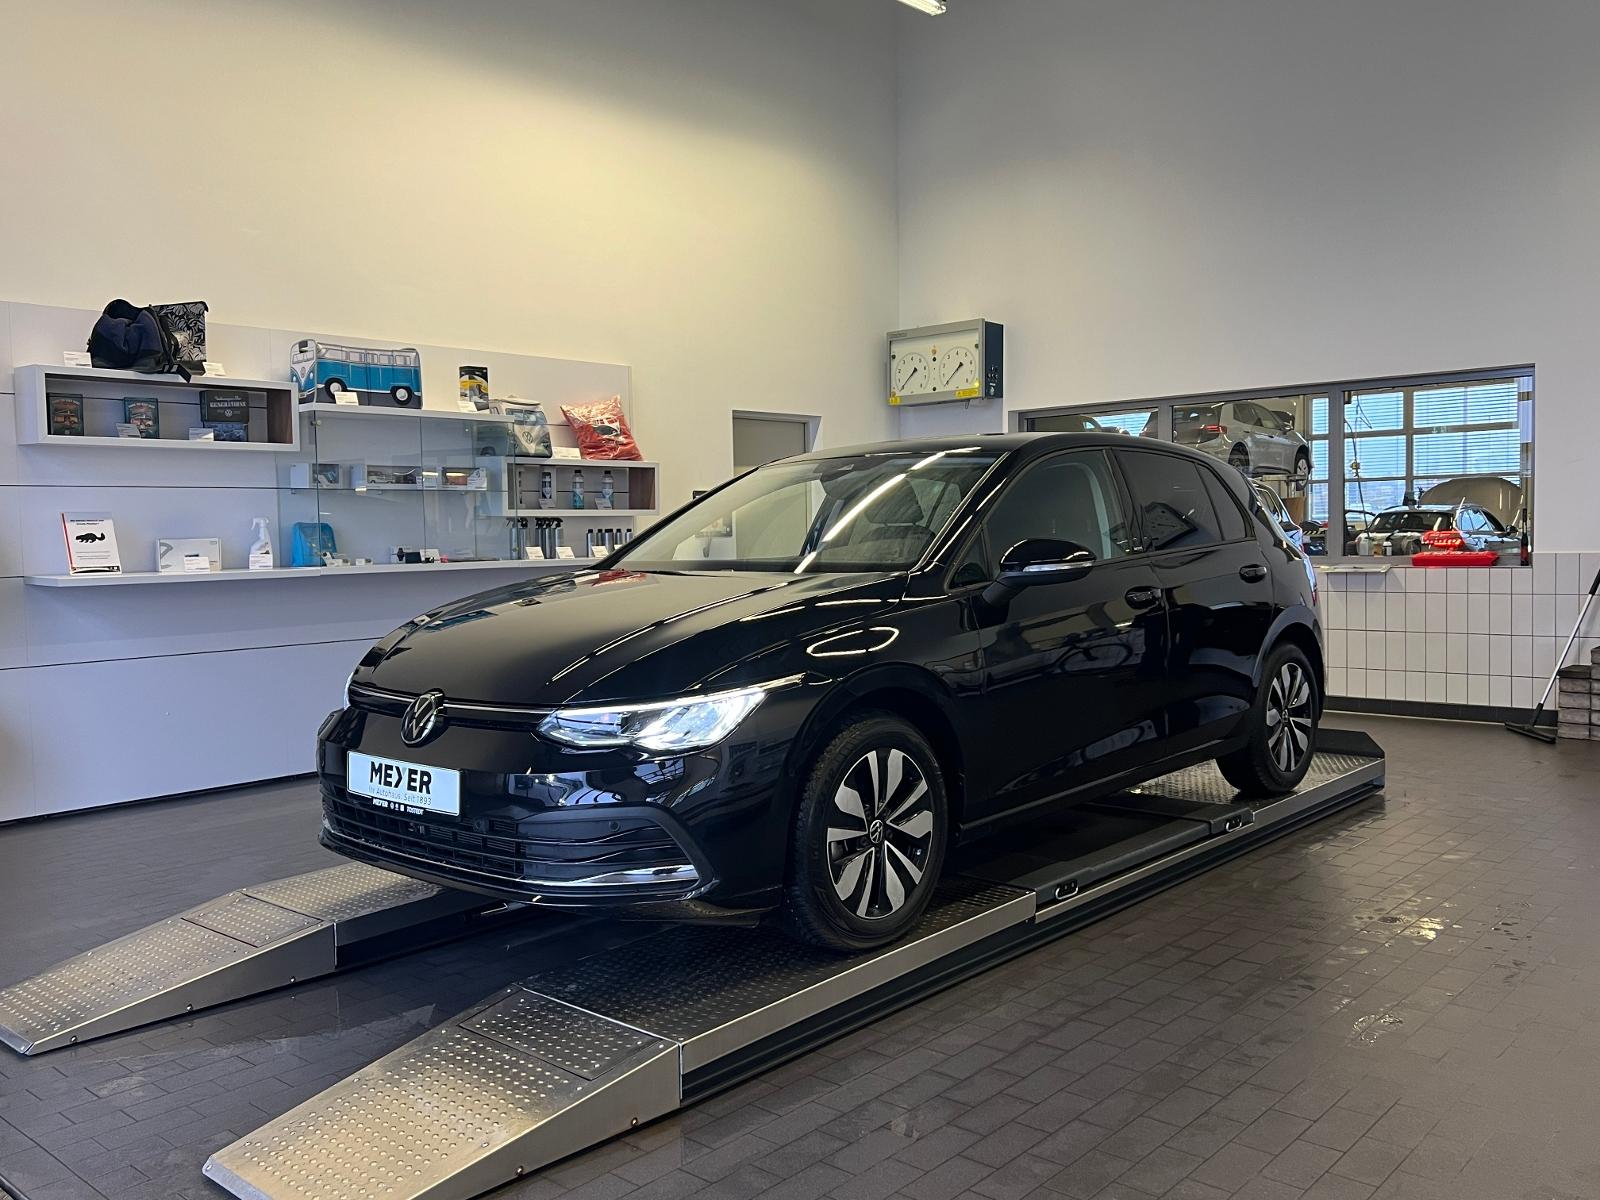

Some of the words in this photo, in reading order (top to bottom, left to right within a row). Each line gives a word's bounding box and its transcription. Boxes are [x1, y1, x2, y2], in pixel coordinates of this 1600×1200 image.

[369, 761, 432, 794] MEYER
[403, 793, 416, 803] Seit
[416, 796, 432, 806] 1893
